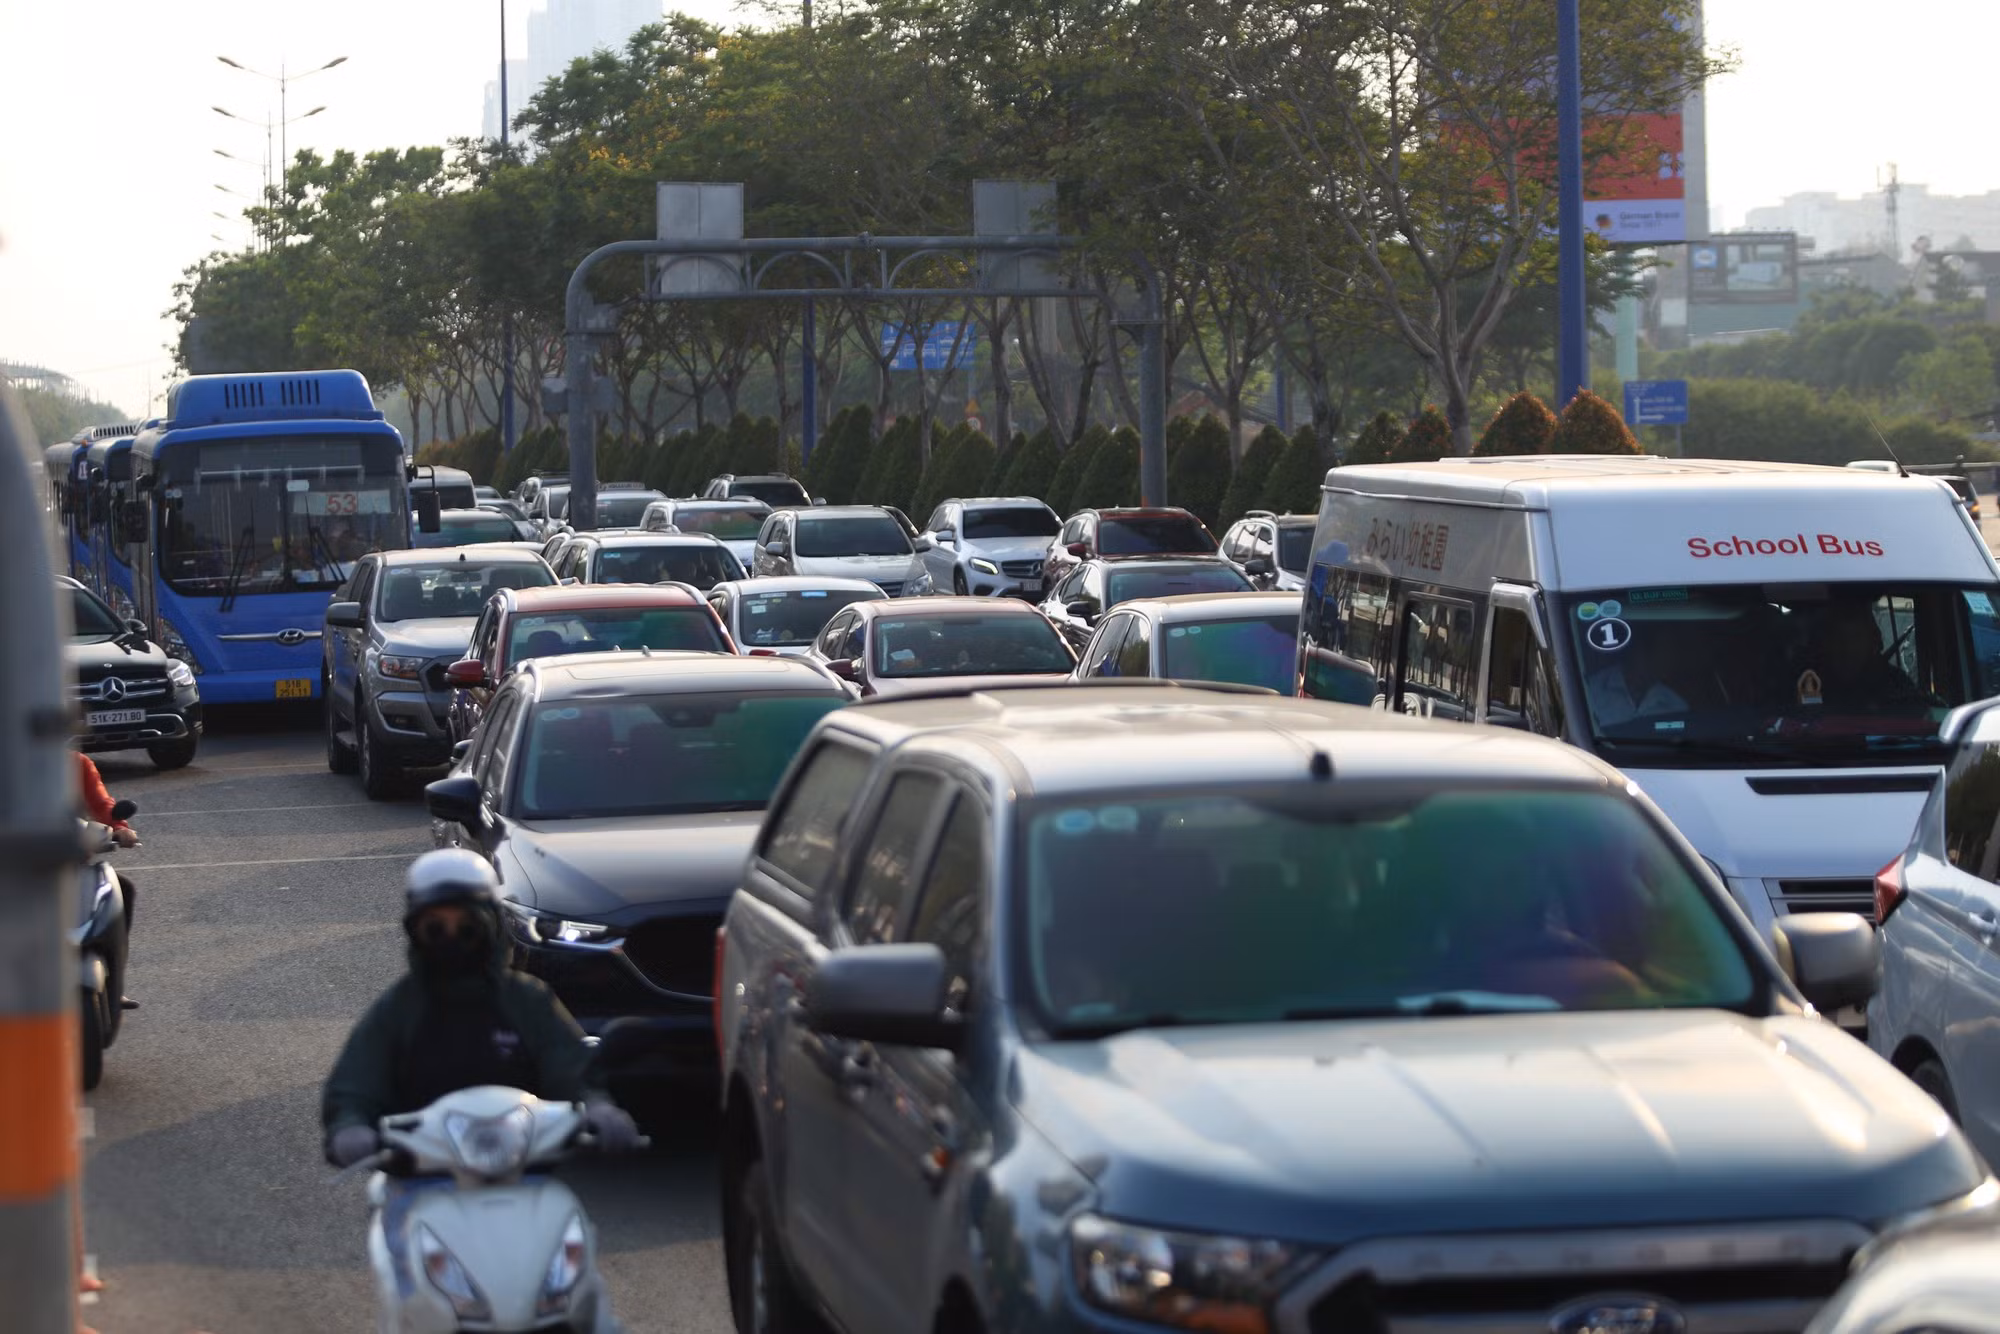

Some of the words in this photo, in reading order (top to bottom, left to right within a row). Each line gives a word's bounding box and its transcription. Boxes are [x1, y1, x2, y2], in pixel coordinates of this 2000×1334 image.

[326, 494, 356, 514] 53
[1366, 517, 1449, 571] みらい幼稚園
[1687, 533, 1809, 558] School
[1816, 534, 1884, 556] Bus
[1600, 623, 1619, 645] 1
